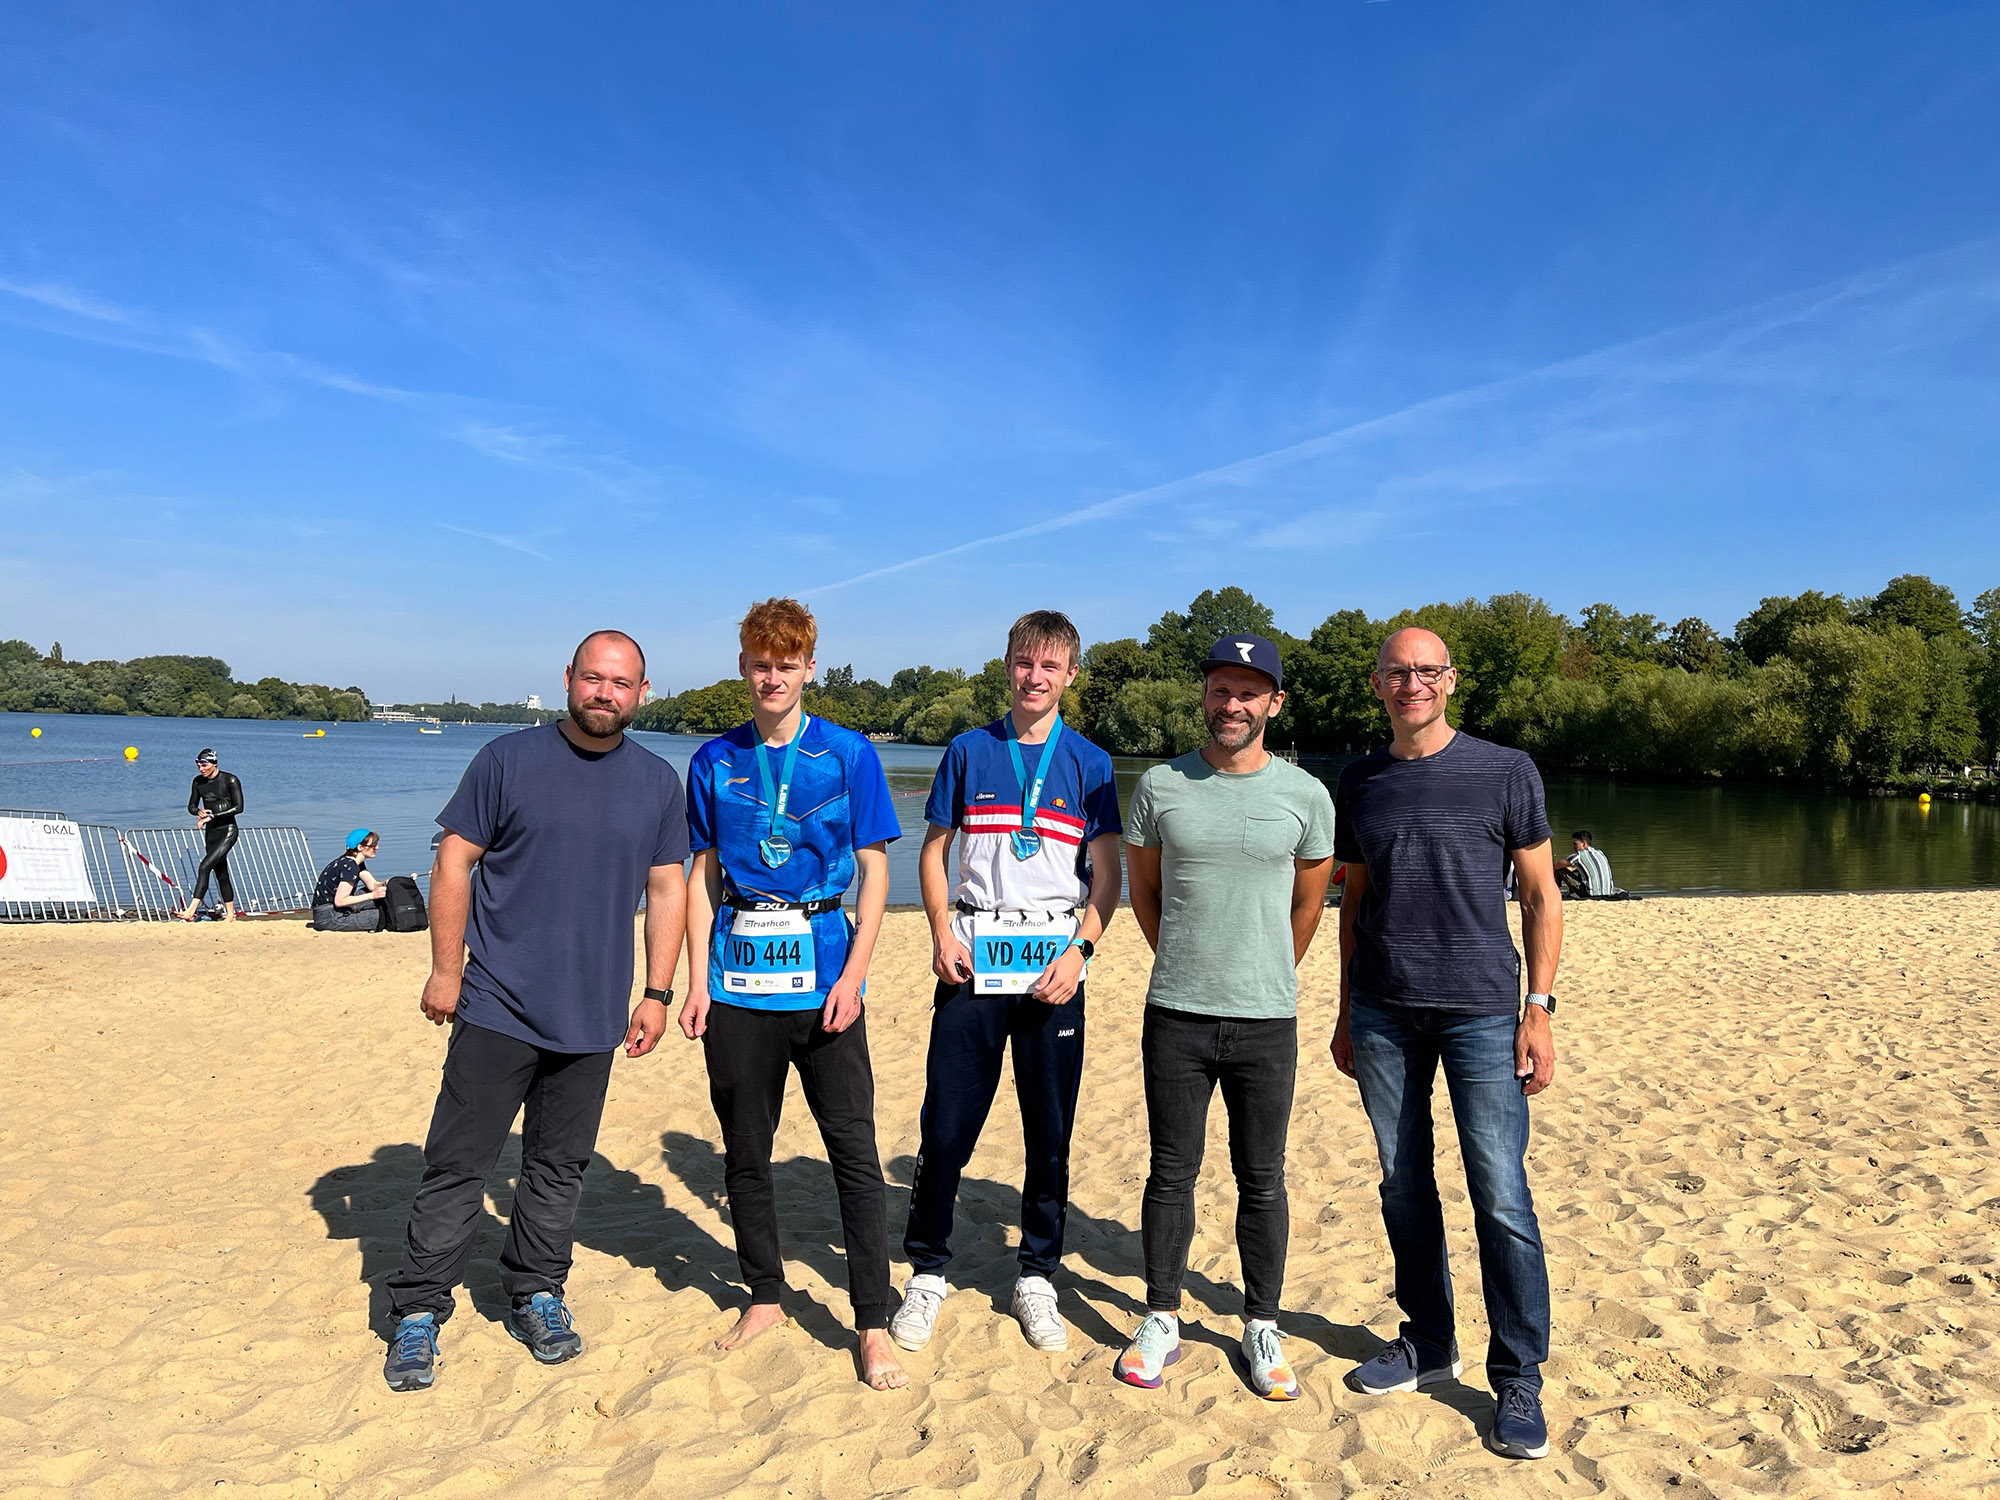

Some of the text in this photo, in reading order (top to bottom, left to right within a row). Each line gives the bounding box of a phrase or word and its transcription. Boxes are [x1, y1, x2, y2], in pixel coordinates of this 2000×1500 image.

[43, 824, 75, 835] OKAL
[754, 902, 789, 911] 2XU
[733, 940, 801, 966] VD 444
[986, 941, 1057, 967] VD 442
[1057, 1028, 1075, 1037] JAKO
